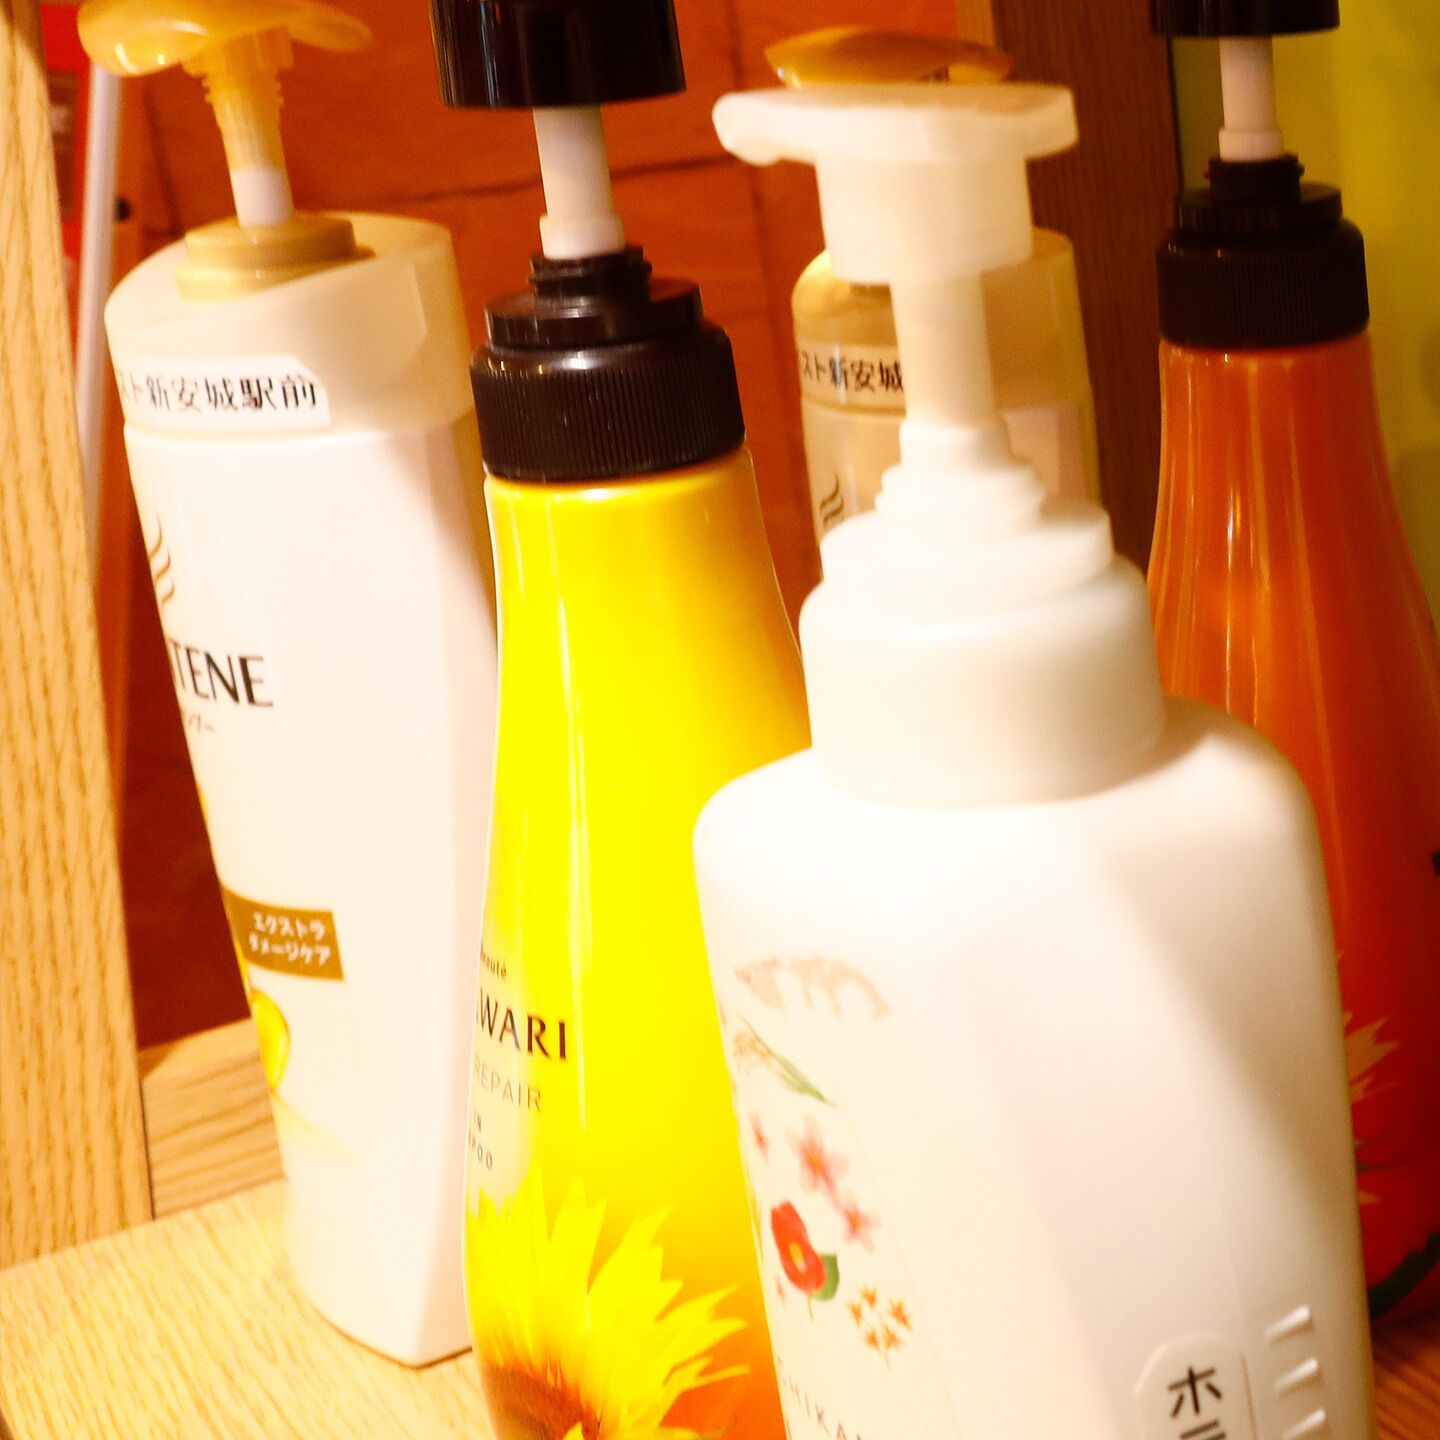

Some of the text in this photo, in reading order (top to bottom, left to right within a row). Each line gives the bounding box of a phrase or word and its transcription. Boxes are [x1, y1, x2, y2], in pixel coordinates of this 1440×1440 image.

[168, 637, 273, 707] TENE
[253, 911, 325, 942] エクストラ
[477, 986, 566, 1061] WARI
[475, 1055, 541, 1113] REPAIR
